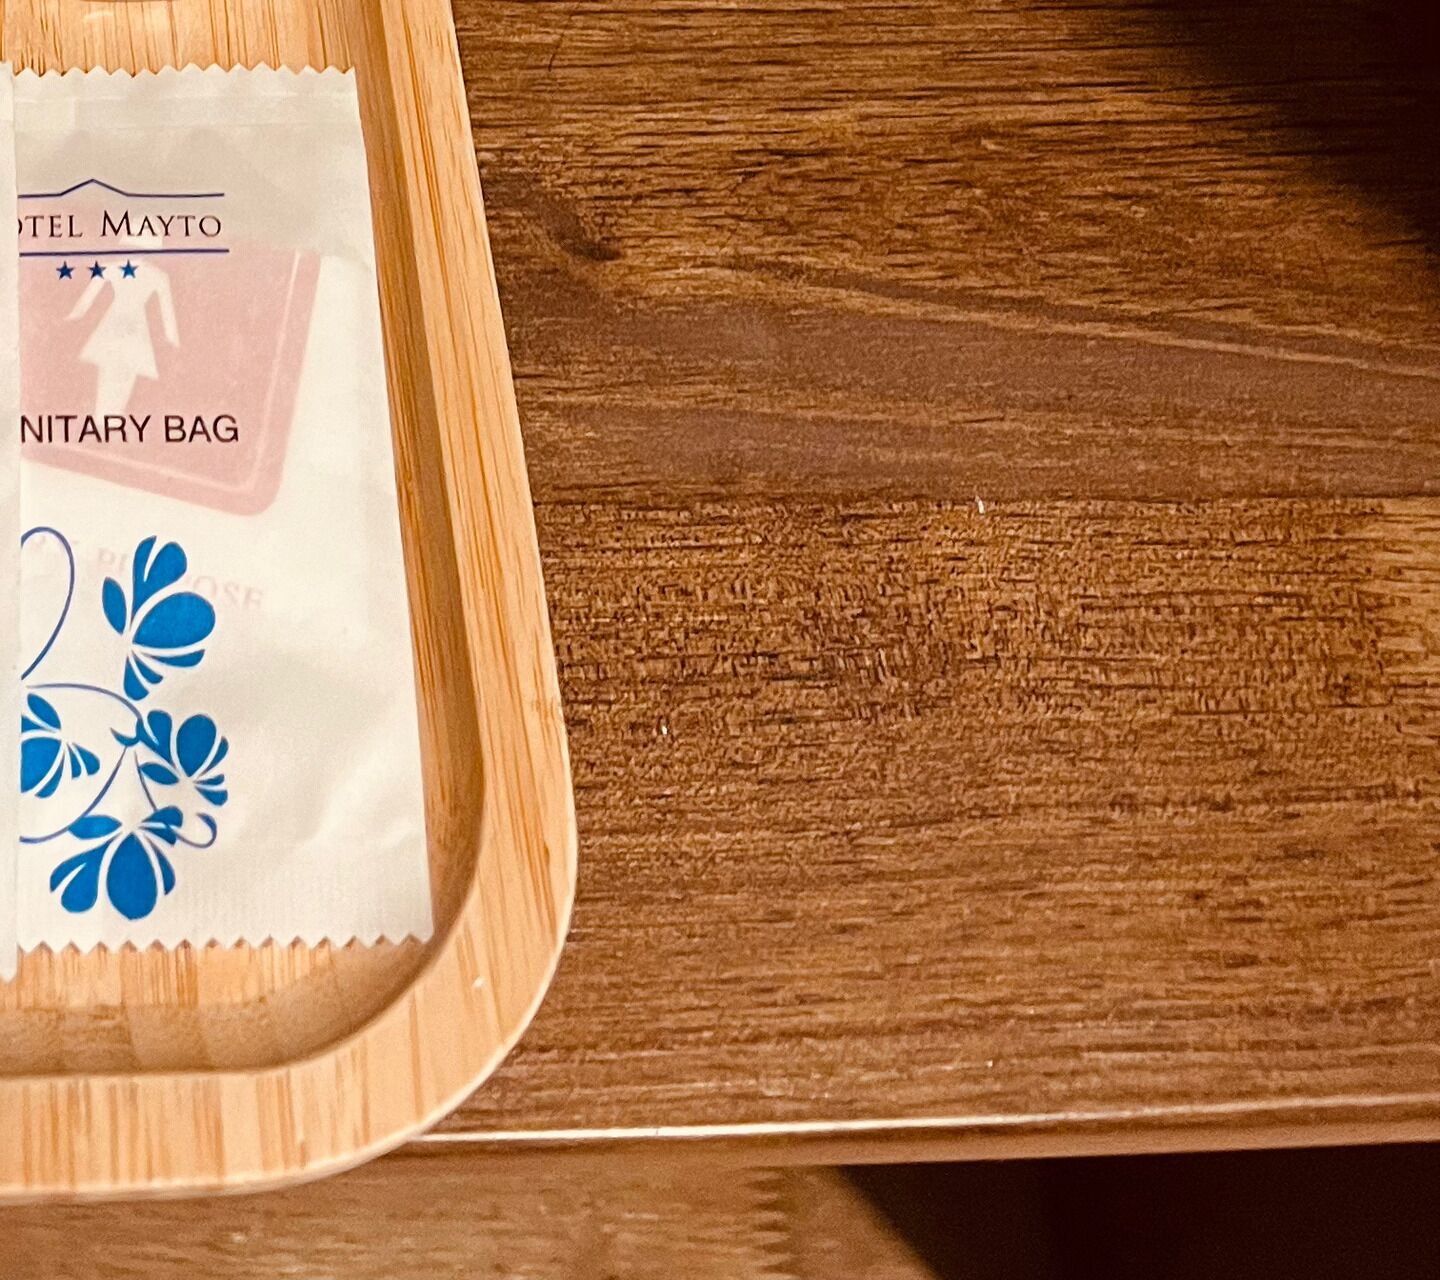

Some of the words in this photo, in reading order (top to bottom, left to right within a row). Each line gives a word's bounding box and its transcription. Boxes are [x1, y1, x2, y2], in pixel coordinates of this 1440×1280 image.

[100, 209, 222, 239] MAYTO
[19, 414, 152, 444] NITARY
[163, 414, 240, 444] BAG
